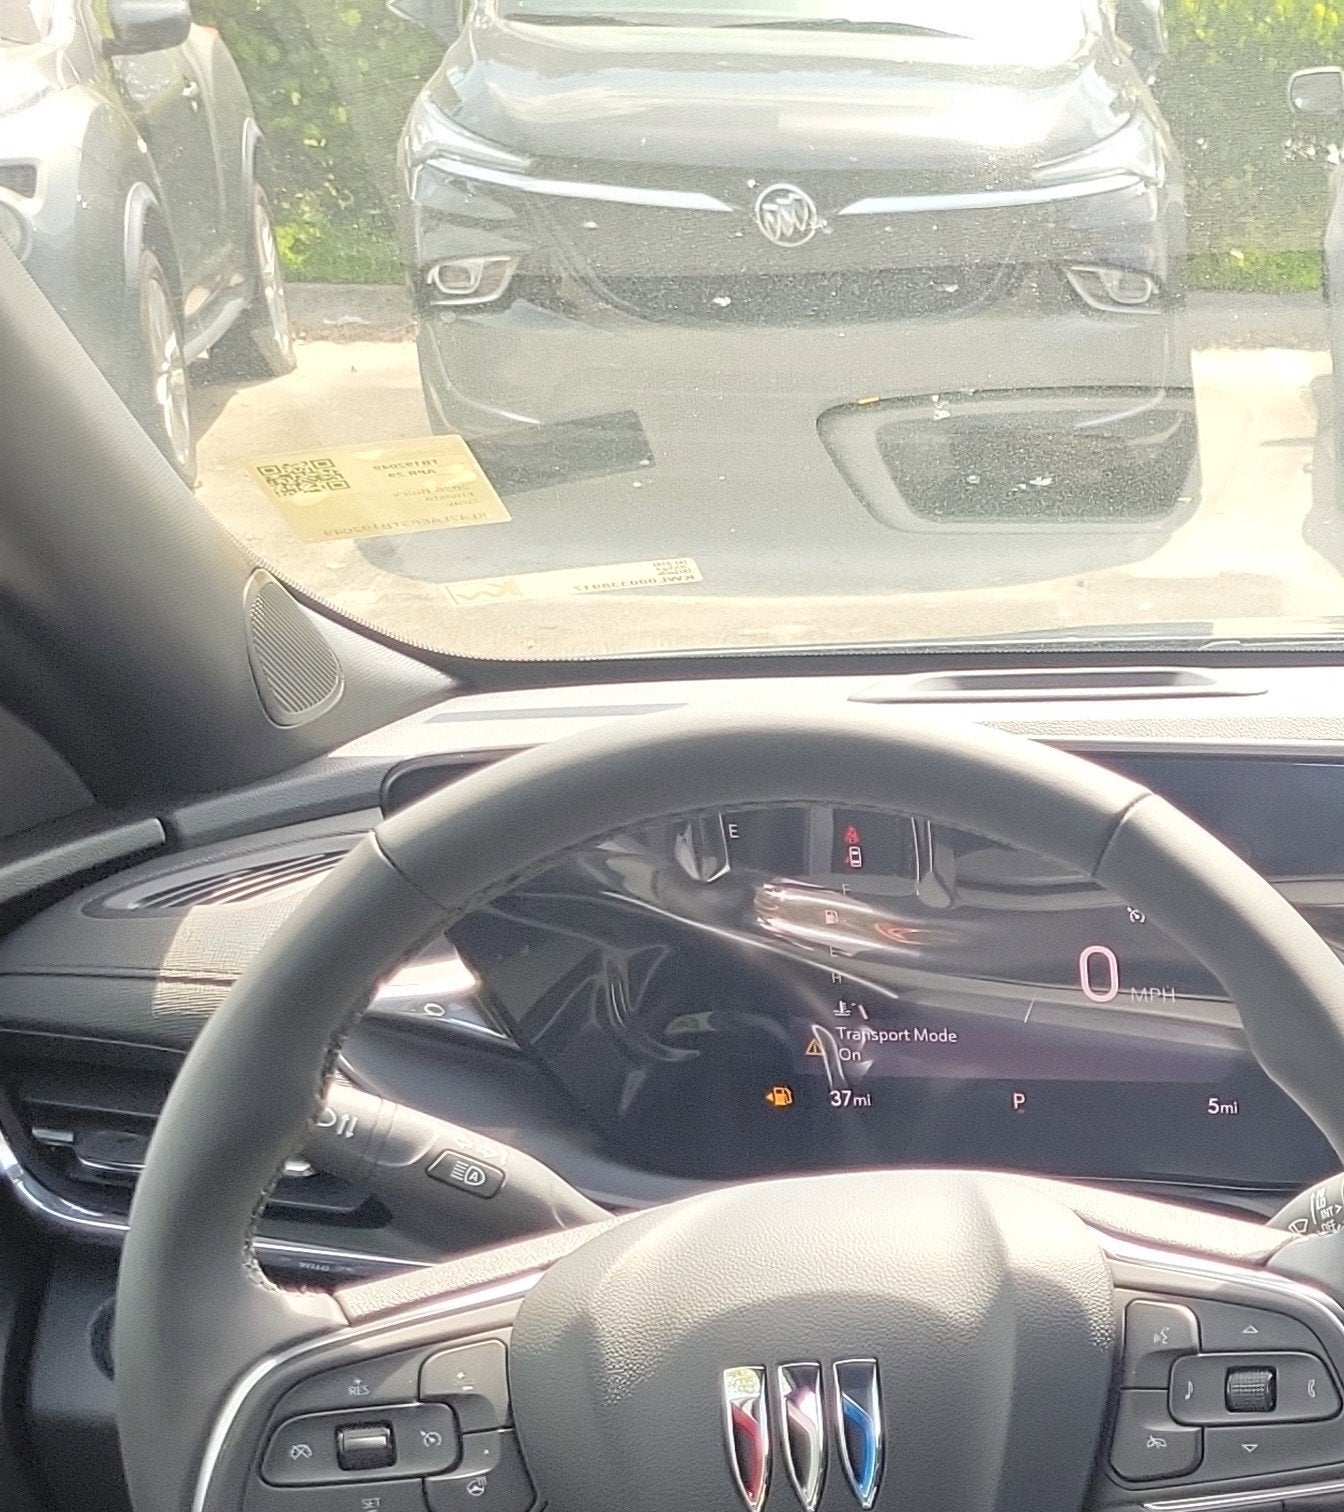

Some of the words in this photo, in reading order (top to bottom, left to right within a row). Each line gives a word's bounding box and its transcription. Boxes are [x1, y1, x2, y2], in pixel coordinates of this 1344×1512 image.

[1080, 945, 1119, 1002] 0
[1130, 986, 1176, 1002] MPH
[837, 1027, 910, 1045] Transport
[914, 1028, 957, 1043] Mode
[839, 1048, 861, 1062] On
[1013, 1093, 1025, 1110] P
